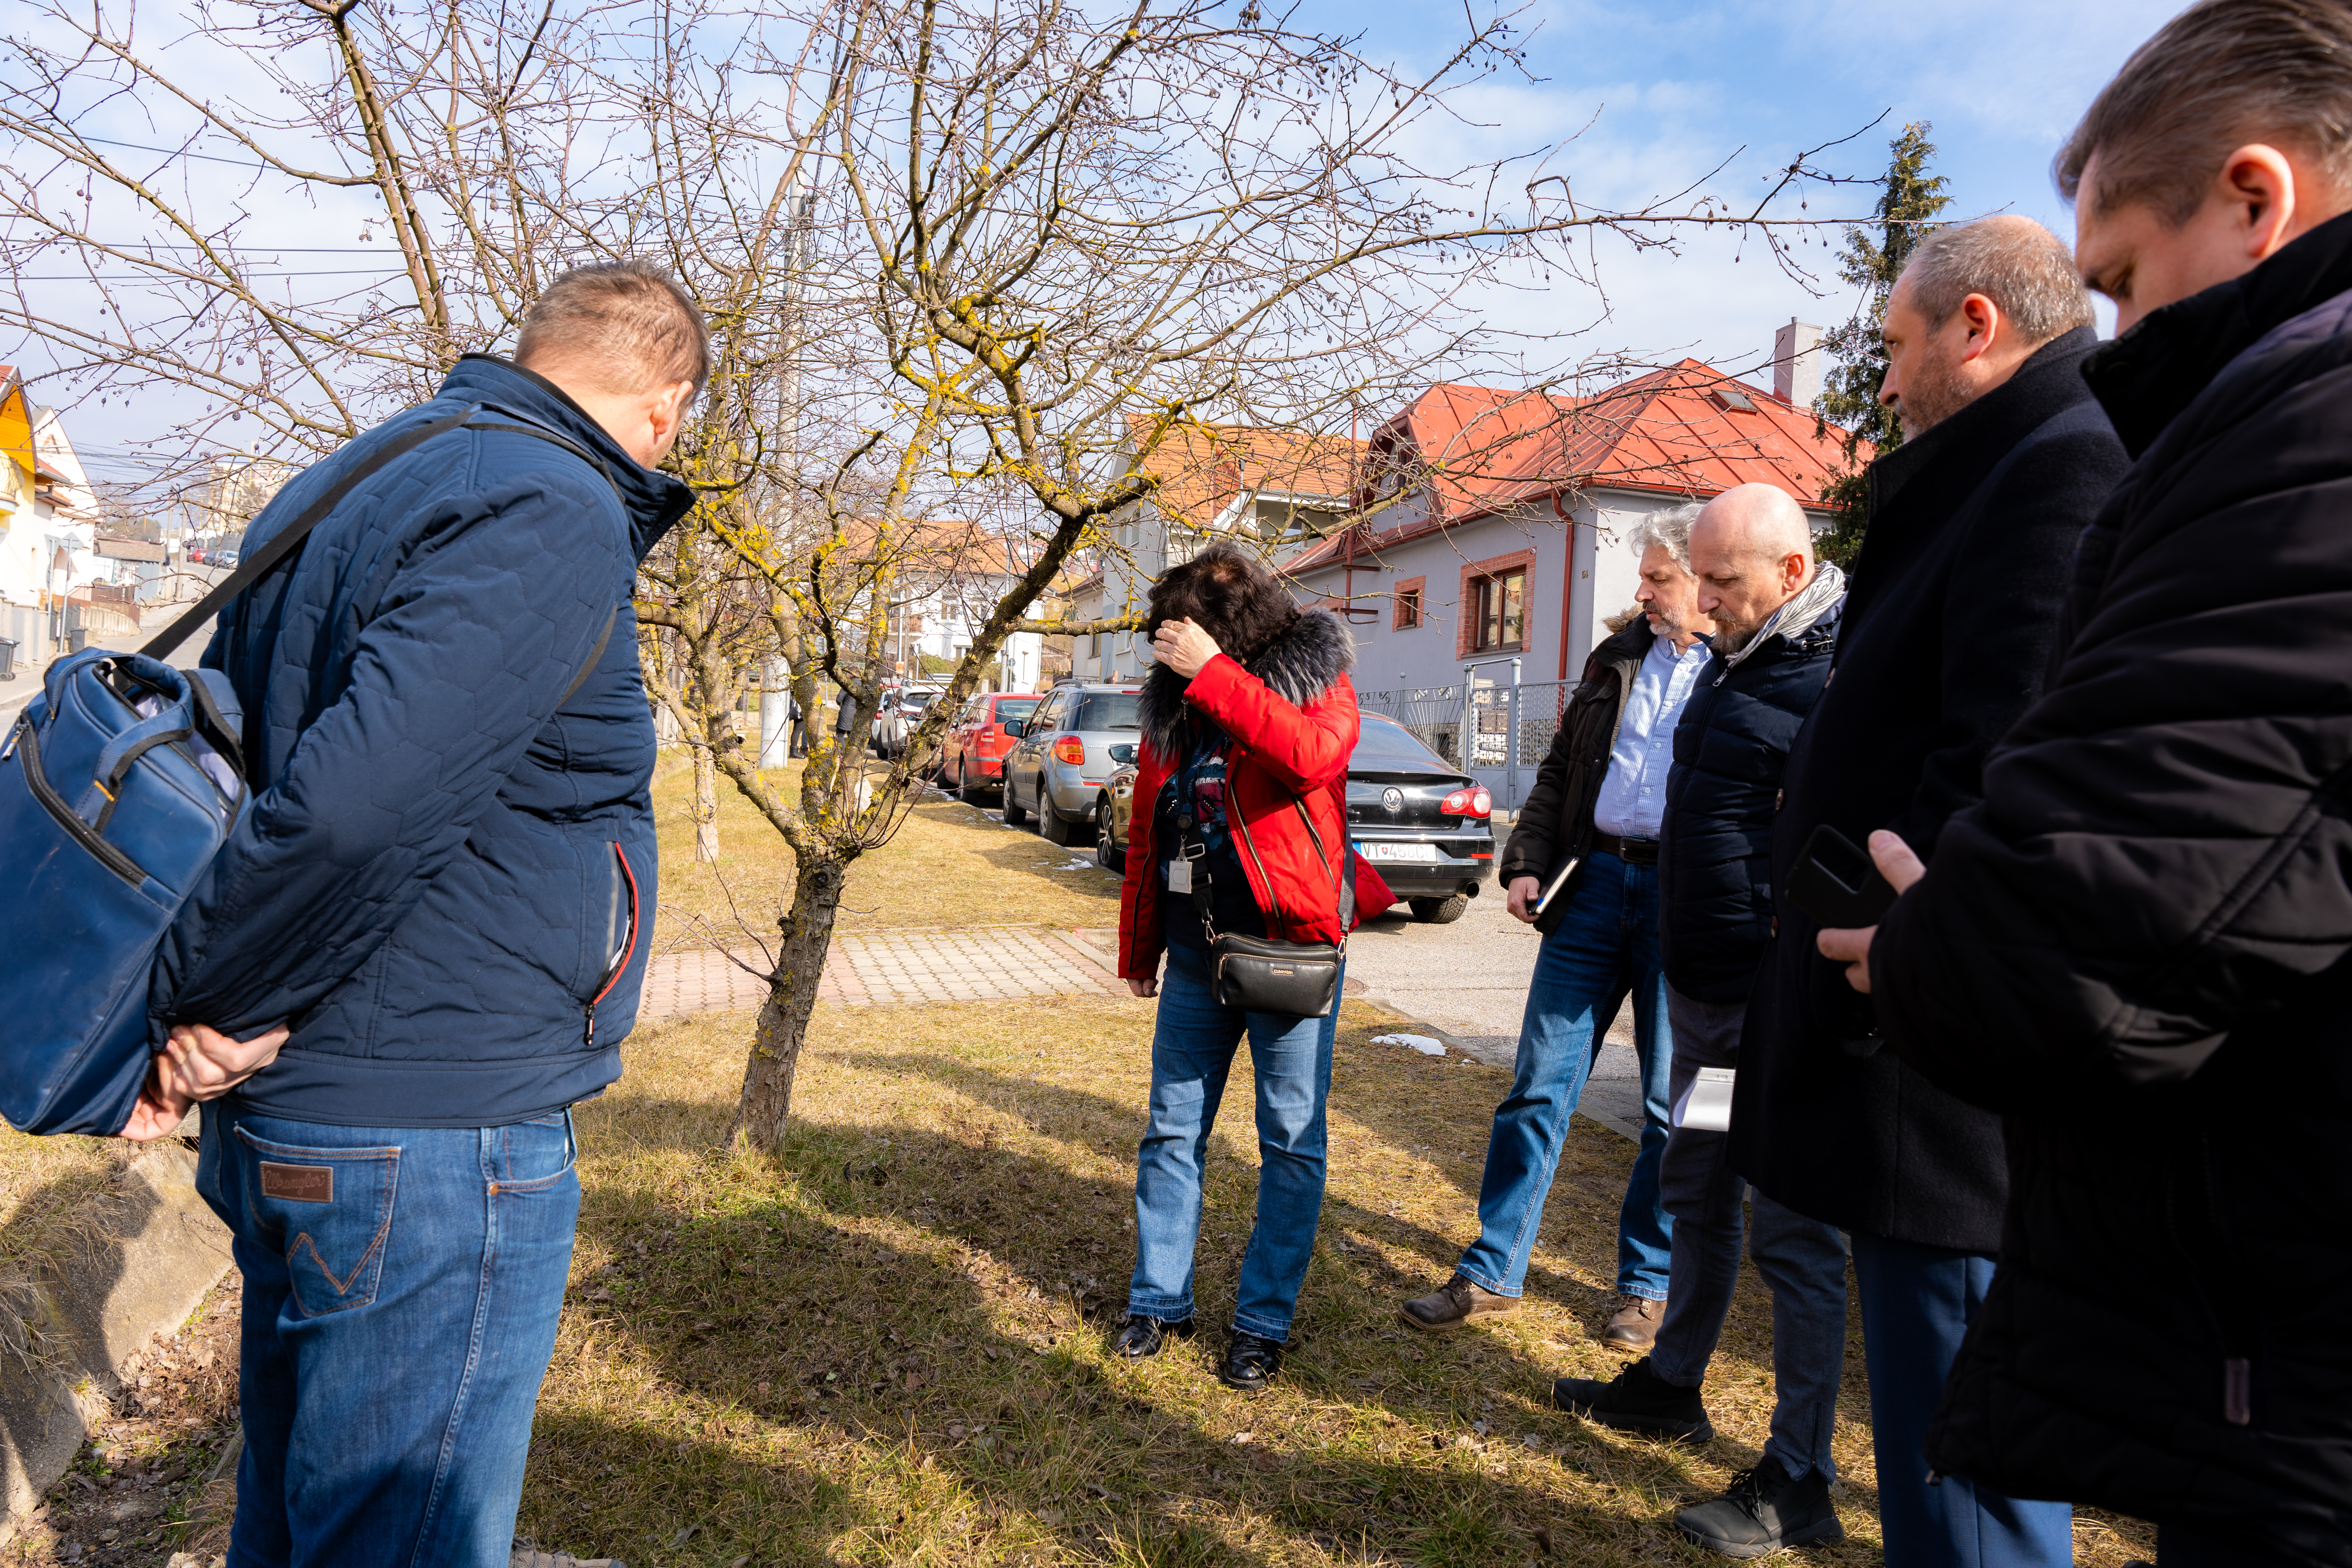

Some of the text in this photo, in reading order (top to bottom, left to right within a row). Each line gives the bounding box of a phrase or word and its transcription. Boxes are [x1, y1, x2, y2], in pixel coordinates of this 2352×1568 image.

[1582, 570, 1588, 579] 54
[1197, 751, 1211, 765] KOŠICE
[1363, 844, 1380, 858] VT
[265, 1170, 326, 1195] Wrangler
